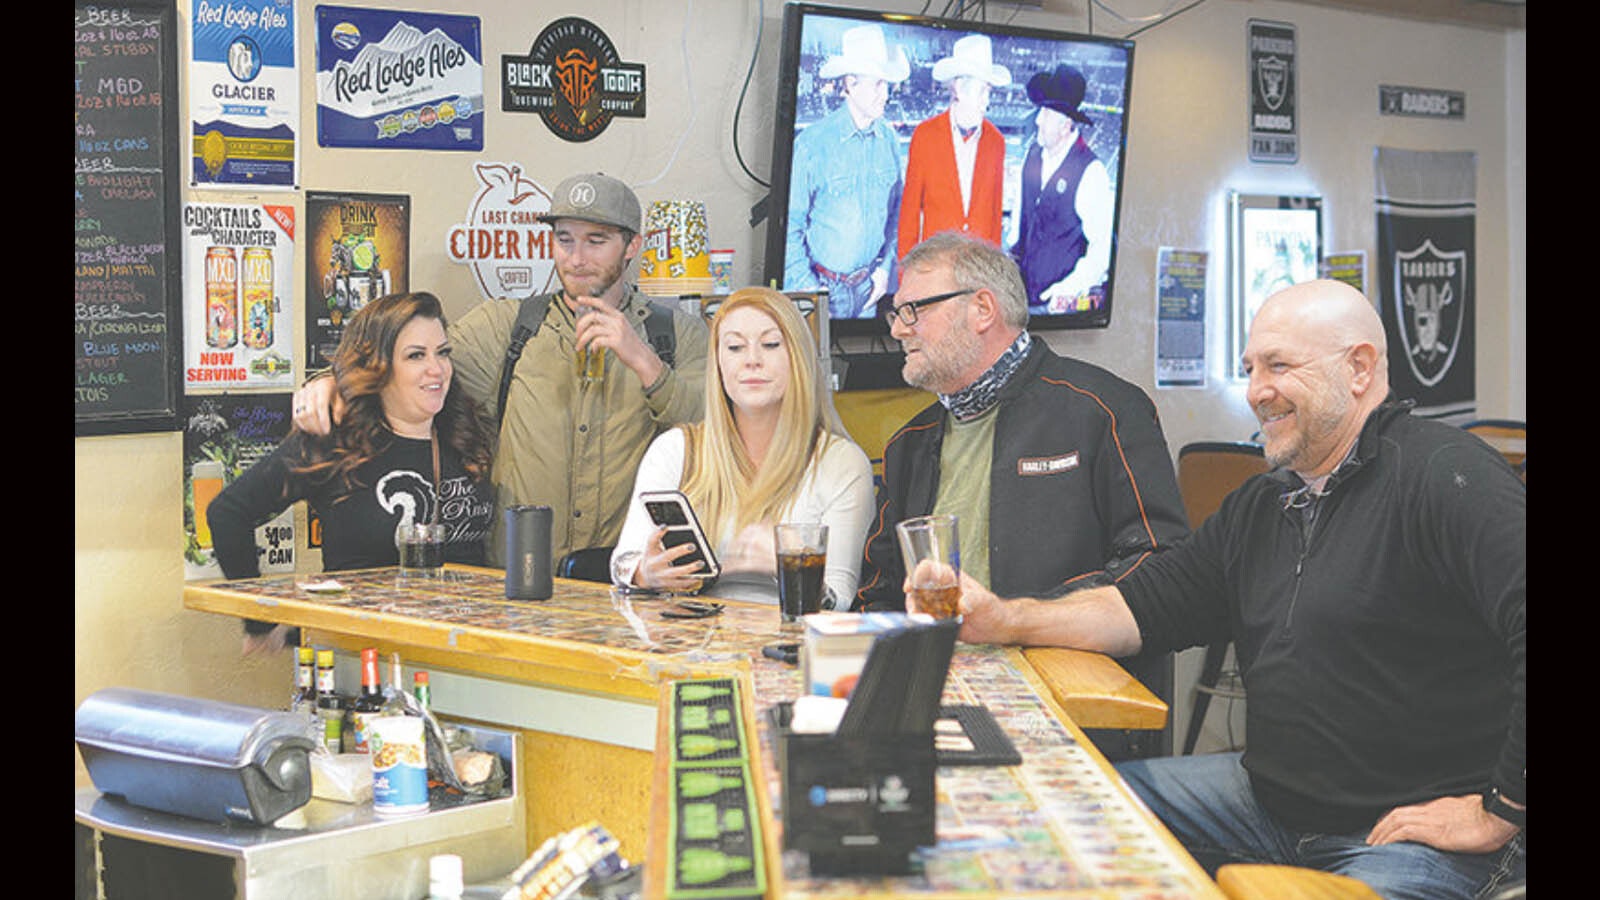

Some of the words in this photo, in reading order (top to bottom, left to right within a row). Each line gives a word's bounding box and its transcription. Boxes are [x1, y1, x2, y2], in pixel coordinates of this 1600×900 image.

[87, 8, 131, 22] BEER
[198, 1, 223, 26] Red
[224, 4, 259, 30] Lodge
[259, 6, 287, 31] Ales
[336, 62, 372, 102] Red
[376, 53, 425, 93] Lodge
[429, 43, 466, 78] Ales
[507, 63, 553, 88] BLACK
[600, 68, 641, 92] TOOTH
[97, 78, 143, 95] MGD
[212, 83, 276, 101] GLACIER
[184, 206, 262, 229] COCKTAILS
[340, 204, 378, 222] DRINK
[482, 210, 507, 224] LAST
[212, 229, 278, 246] CHARACTER
[450, 229, 521, 259] CIDER
[527, 229, 555, 259] MI
[208, 257, 237, 283] MXD
[243, 258, 272, 283] MXD
[1403, 261, 1456, 277] RAIDERS
[75, 303, 121, 319] BEER
[83, 341, 119, 356] BLUE
[125, 341, 160, 354] MOON
[200, 352, 235, 366] NOW
[77, 372, 128, 386] LAGER
[186, 368, 248, 382] SERVING
[440, 476, 474, 501] The
[268, 548, 293, 565] CAN
